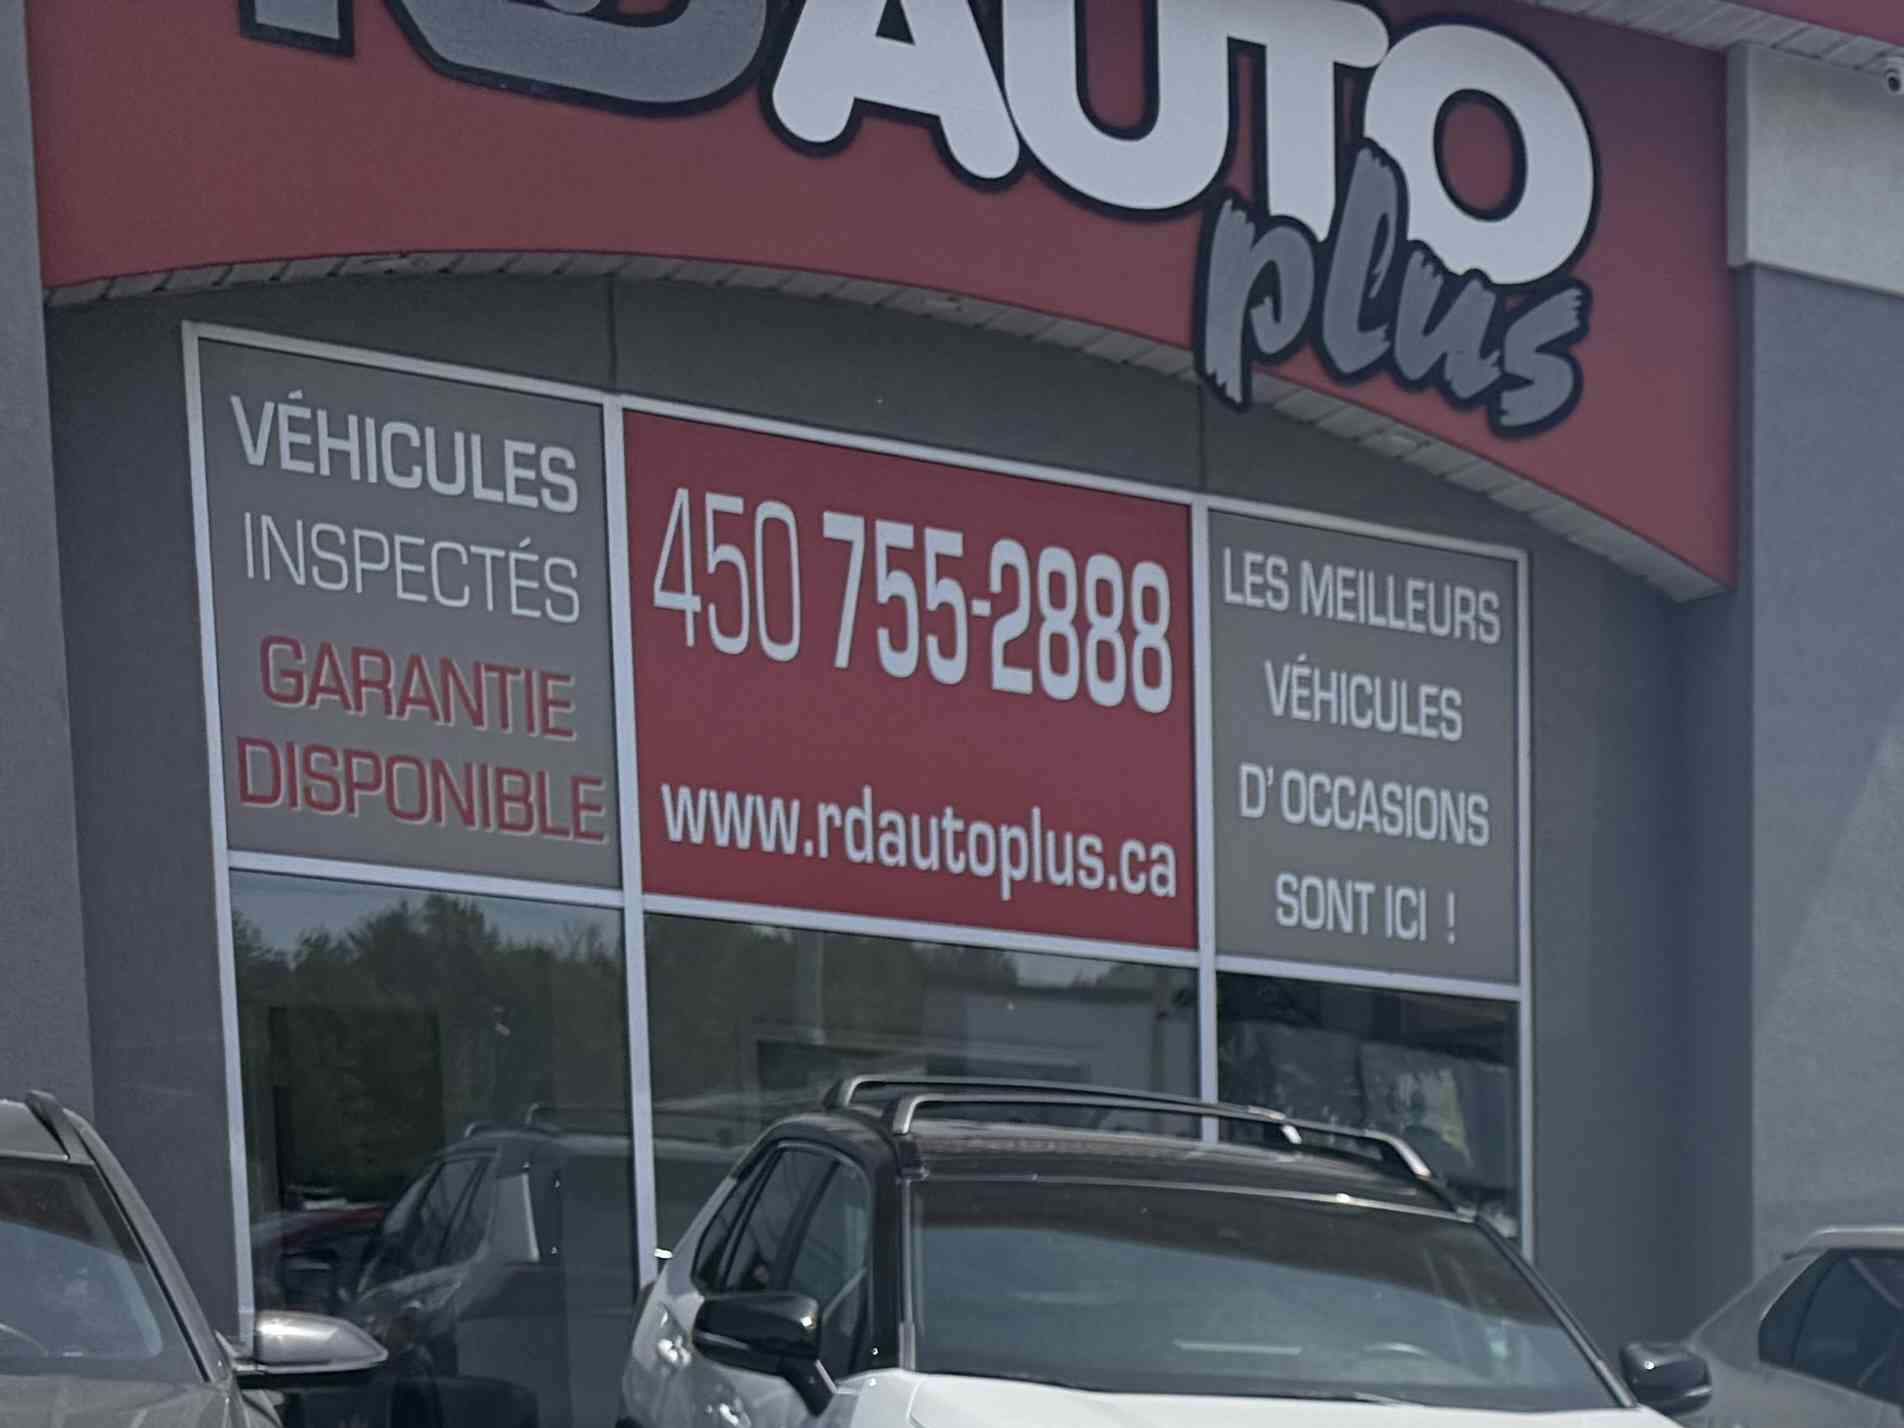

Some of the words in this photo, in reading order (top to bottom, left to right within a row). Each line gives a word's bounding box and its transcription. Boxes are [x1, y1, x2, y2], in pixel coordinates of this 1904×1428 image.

[772, 0, 1593, 285] AUTO
[1204, 147, 1585, 428] plus
[230, 389, 579, 513] VÉHICULES
[244, 512, 581, 623] INSPECTÉS
[653, 487, 801, 663] 450
[823, 511, 1173, 713] 755-2888
[1223, 547, 1289, 612] LES
[1300, 560, 1501, 645] MEILLEURS
[259, 635, 577, 741] GARANTIE
[1264, 653, 1463, 742] VÉHICULES
[236, 736, 608, 845] DISPONIBLE
[661, 784, 1178, 900] www.rdautoplus.ca
[1275, 872, 1376, 936] SONT
[1385, 885, 1427, 941] ICI
